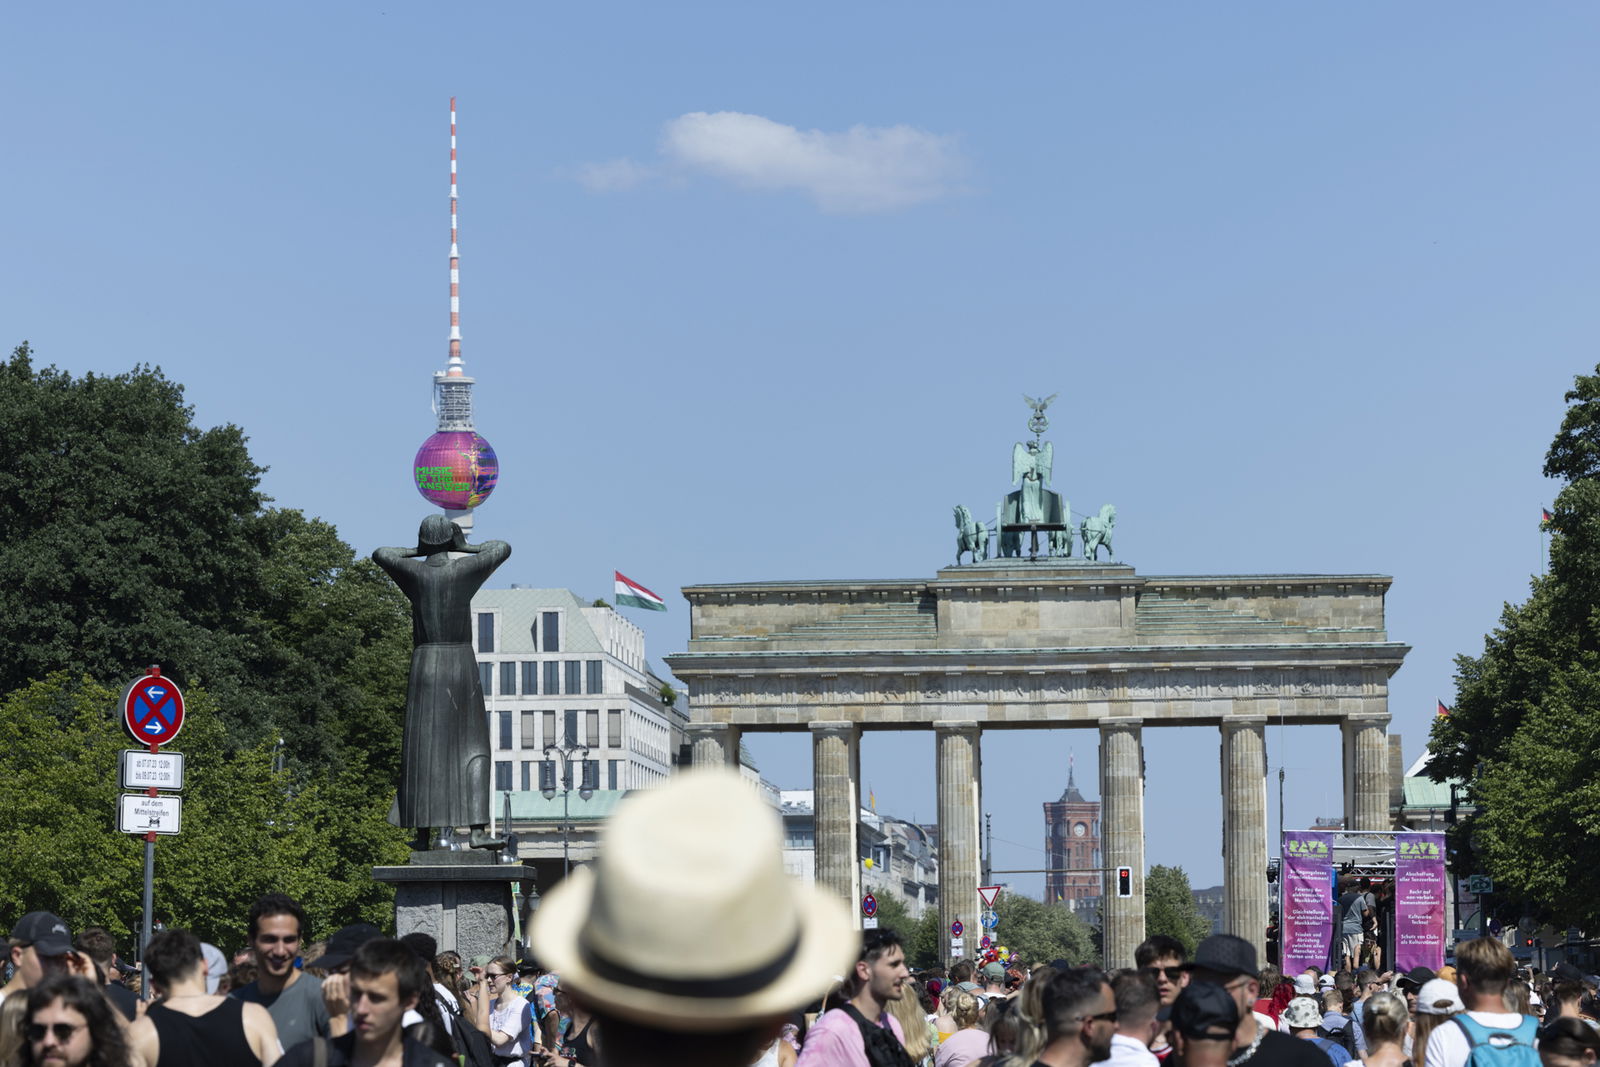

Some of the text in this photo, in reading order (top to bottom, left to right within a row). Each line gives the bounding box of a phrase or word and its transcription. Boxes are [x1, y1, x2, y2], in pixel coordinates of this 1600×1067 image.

[416, 466, 453, 474] MUSIC
[430, 474, 453, 483] THE
[419, 482, 470, 491] ANSWER
[134, 808, 169, 817] Mittelstreifen
